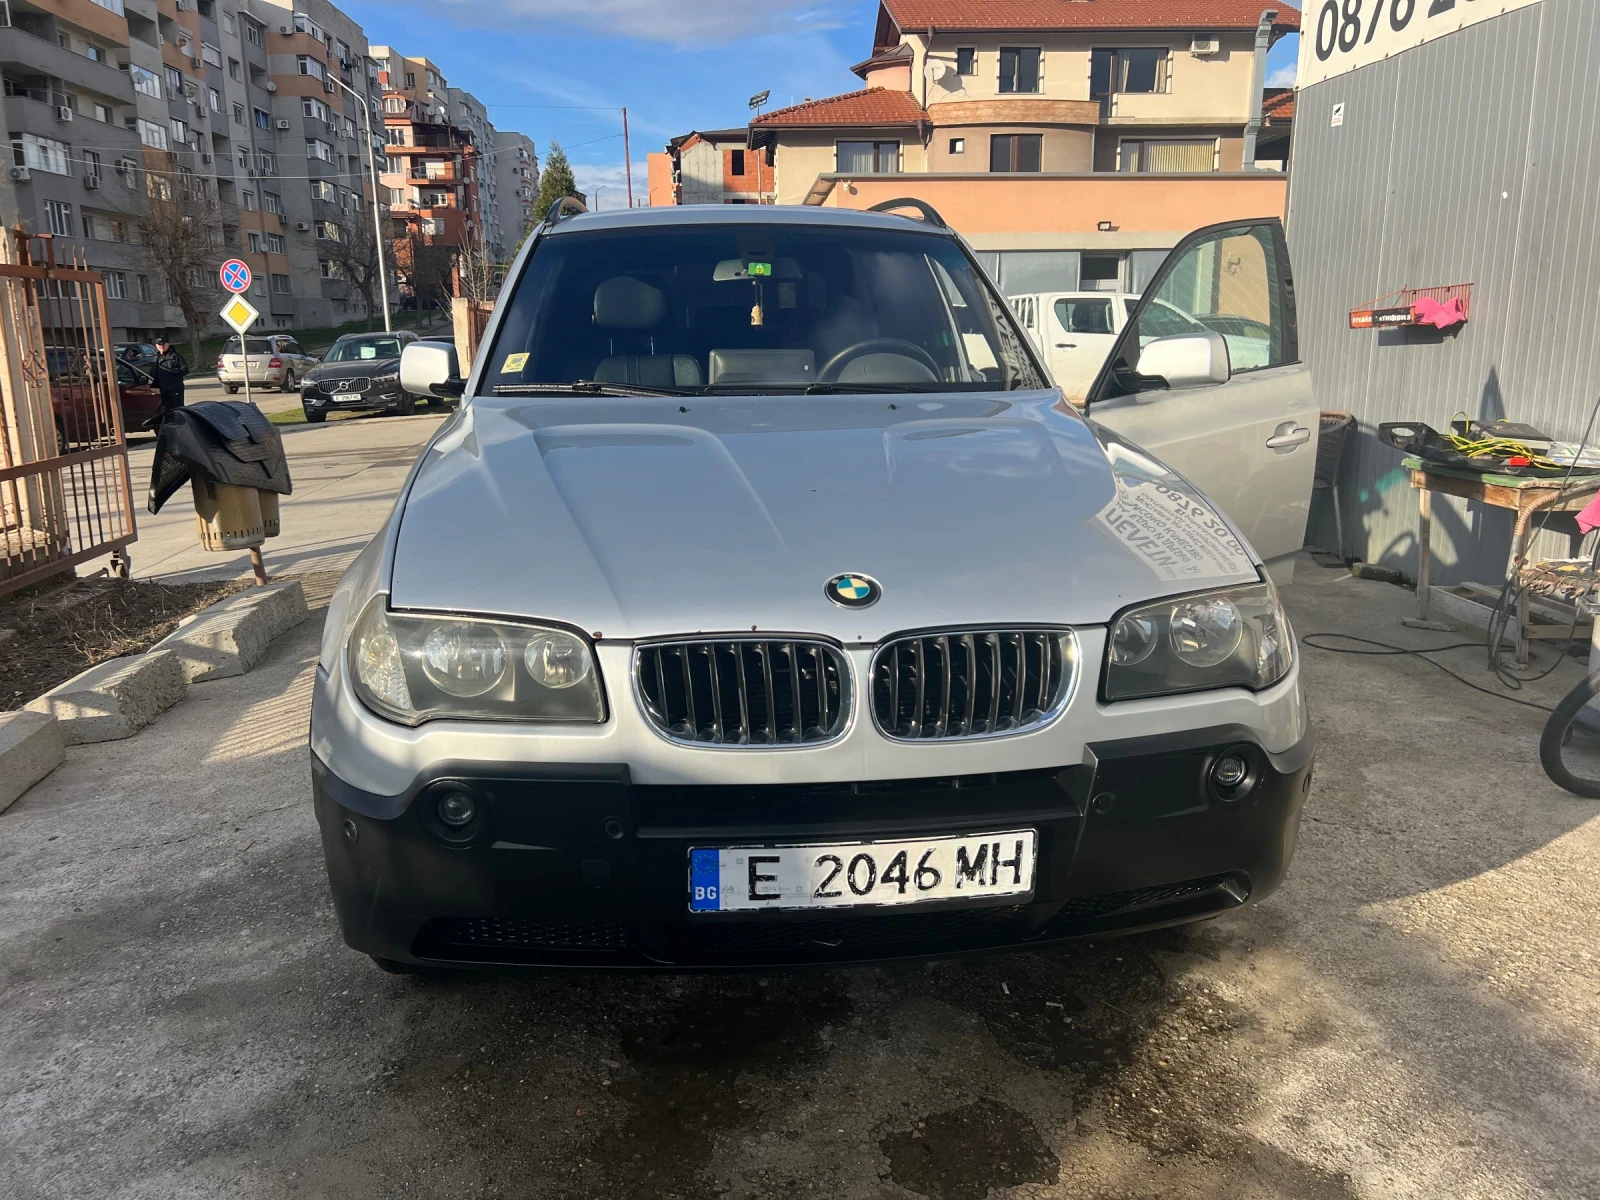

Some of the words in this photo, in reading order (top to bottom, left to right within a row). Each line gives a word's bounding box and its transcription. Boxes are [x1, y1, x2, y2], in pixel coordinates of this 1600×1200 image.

[694, 886, 717, 901] BG
[748, 856, 780, 901] E
[813, 848, 942, 898] 2046
[954, 839, 1024, 889] MH
